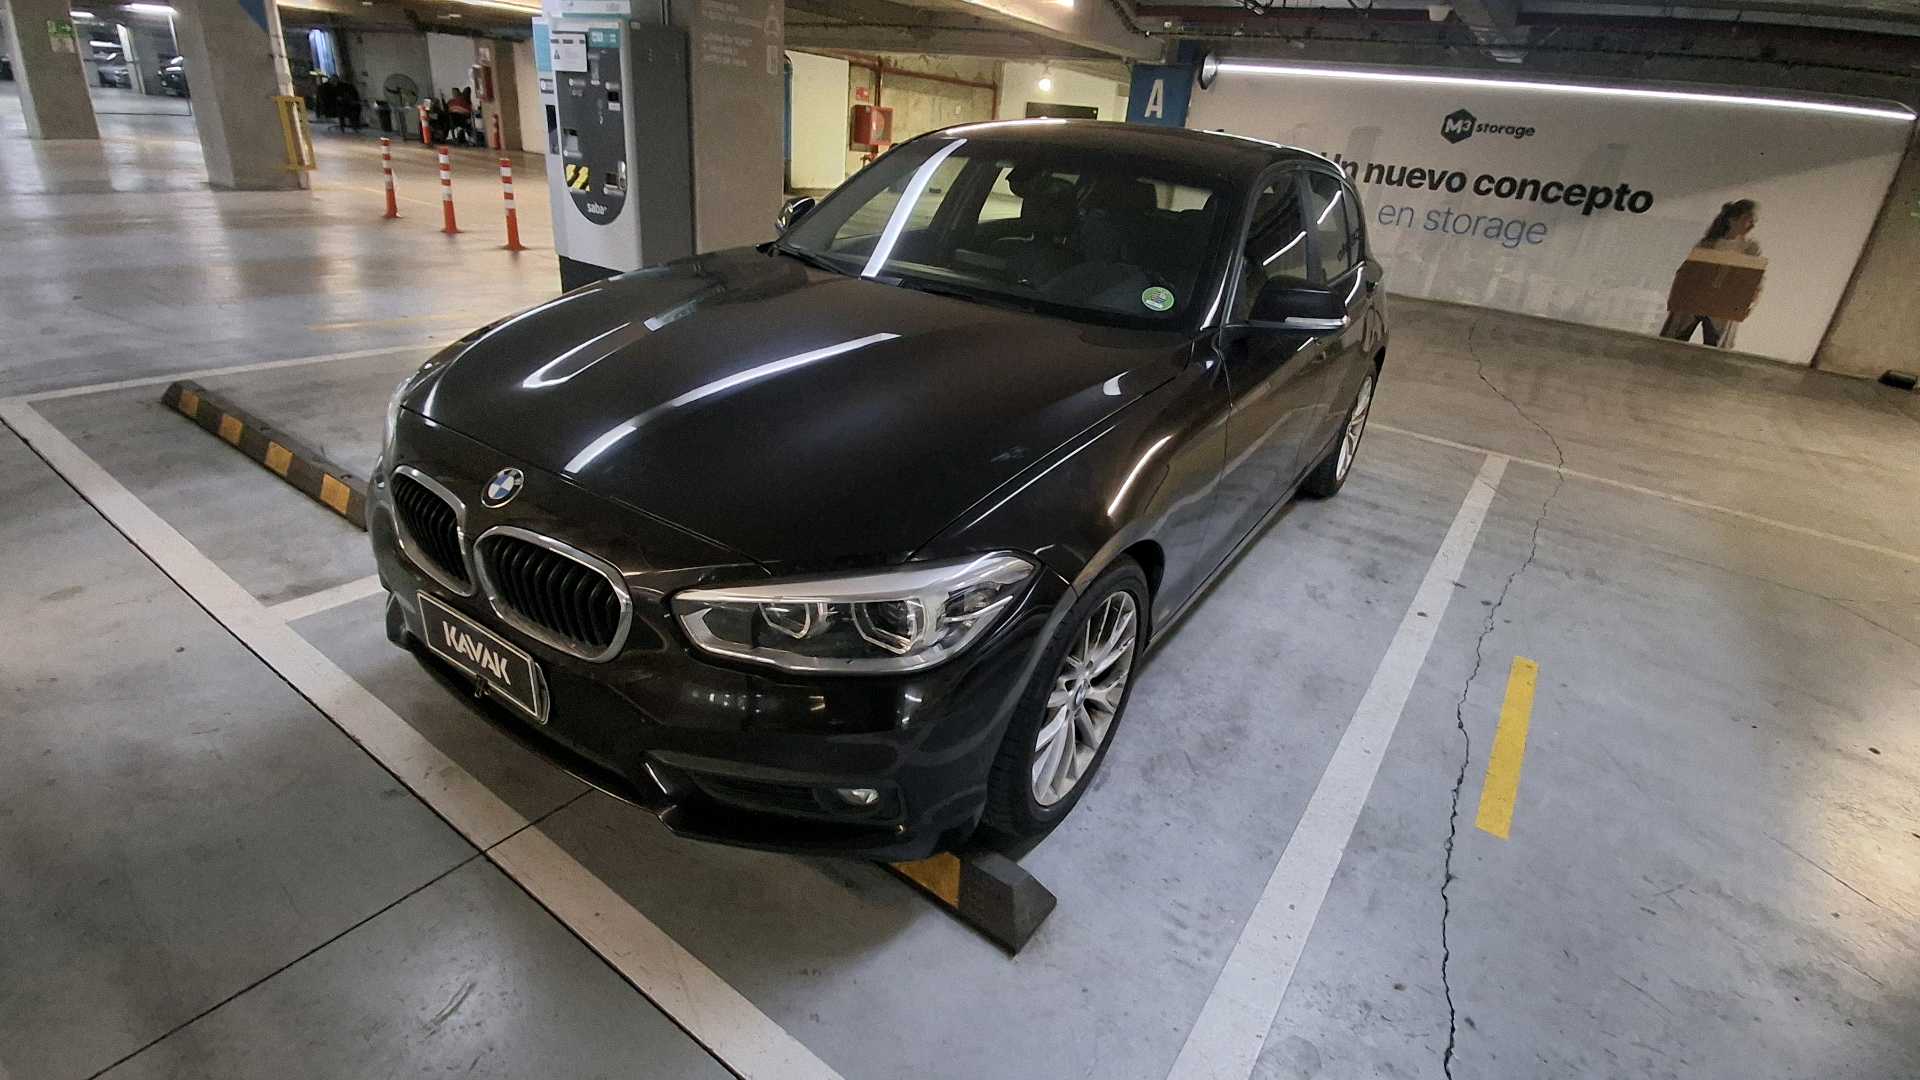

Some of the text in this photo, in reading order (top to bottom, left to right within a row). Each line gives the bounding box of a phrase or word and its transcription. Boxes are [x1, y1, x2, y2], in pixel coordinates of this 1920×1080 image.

[1144, 79, 1164, 118] A
[1476, 123, 1535, 139] storage
[1363, 162, 1467, 194] nuevo
[1472, 173, 1654, 216] concepto
[1378, 204, 1548, 249] en storage
[443, 621, 511, 685] KAVAK
